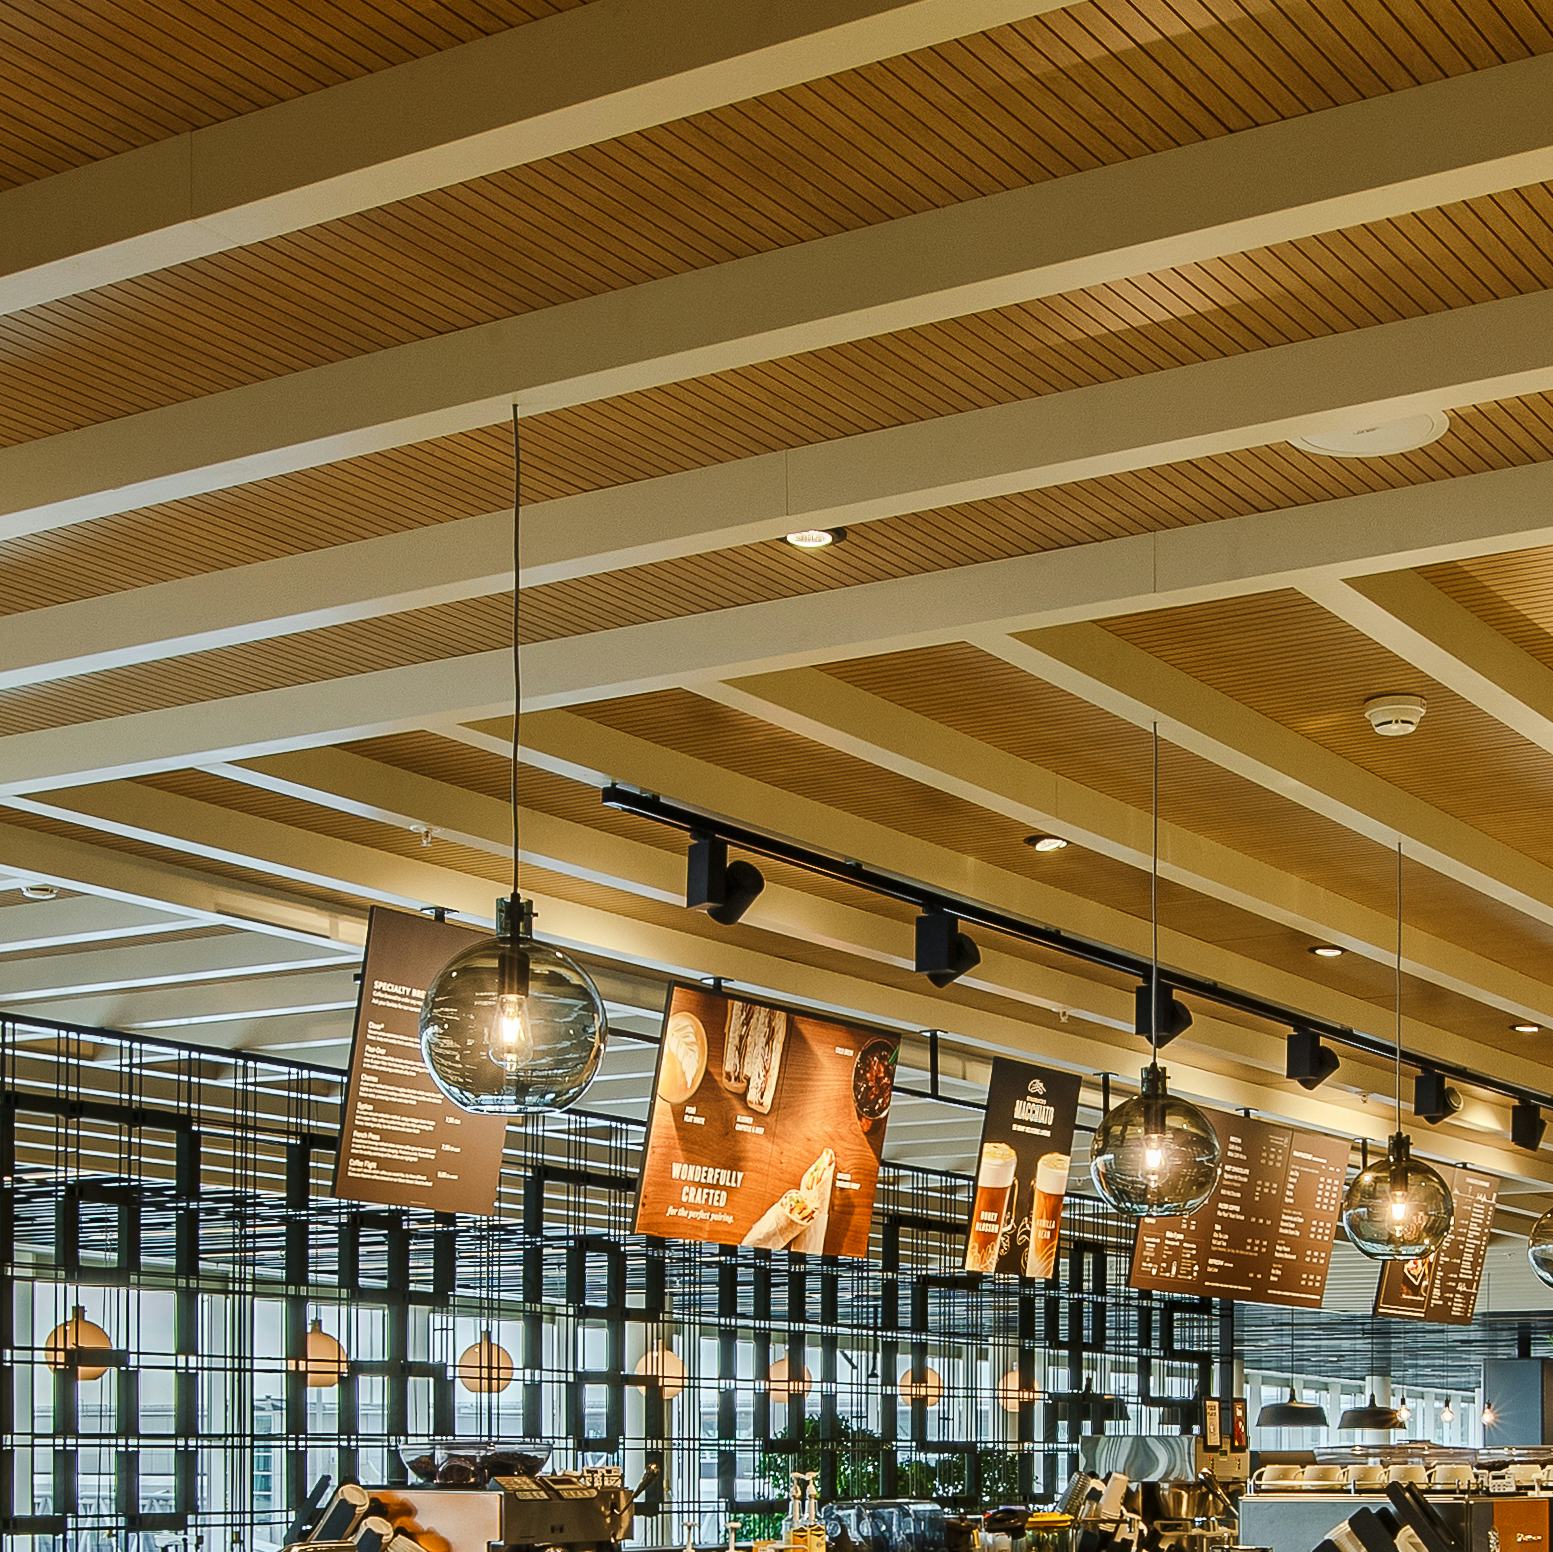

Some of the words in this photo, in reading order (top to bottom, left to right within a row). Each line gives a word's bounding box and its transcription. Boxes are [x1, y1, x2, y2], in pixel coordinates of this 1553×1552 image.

[373, 980, 411, 995] SPECIALTY
[671, 1162, 744, 1188] WONDERFULLY
[681, 1186, 727, 1207] CRAFTED
[666, 1206, 678, 1217] for
[678, 1208, 688, 1218] the
[688, 1209, 710, 1222] perfect
